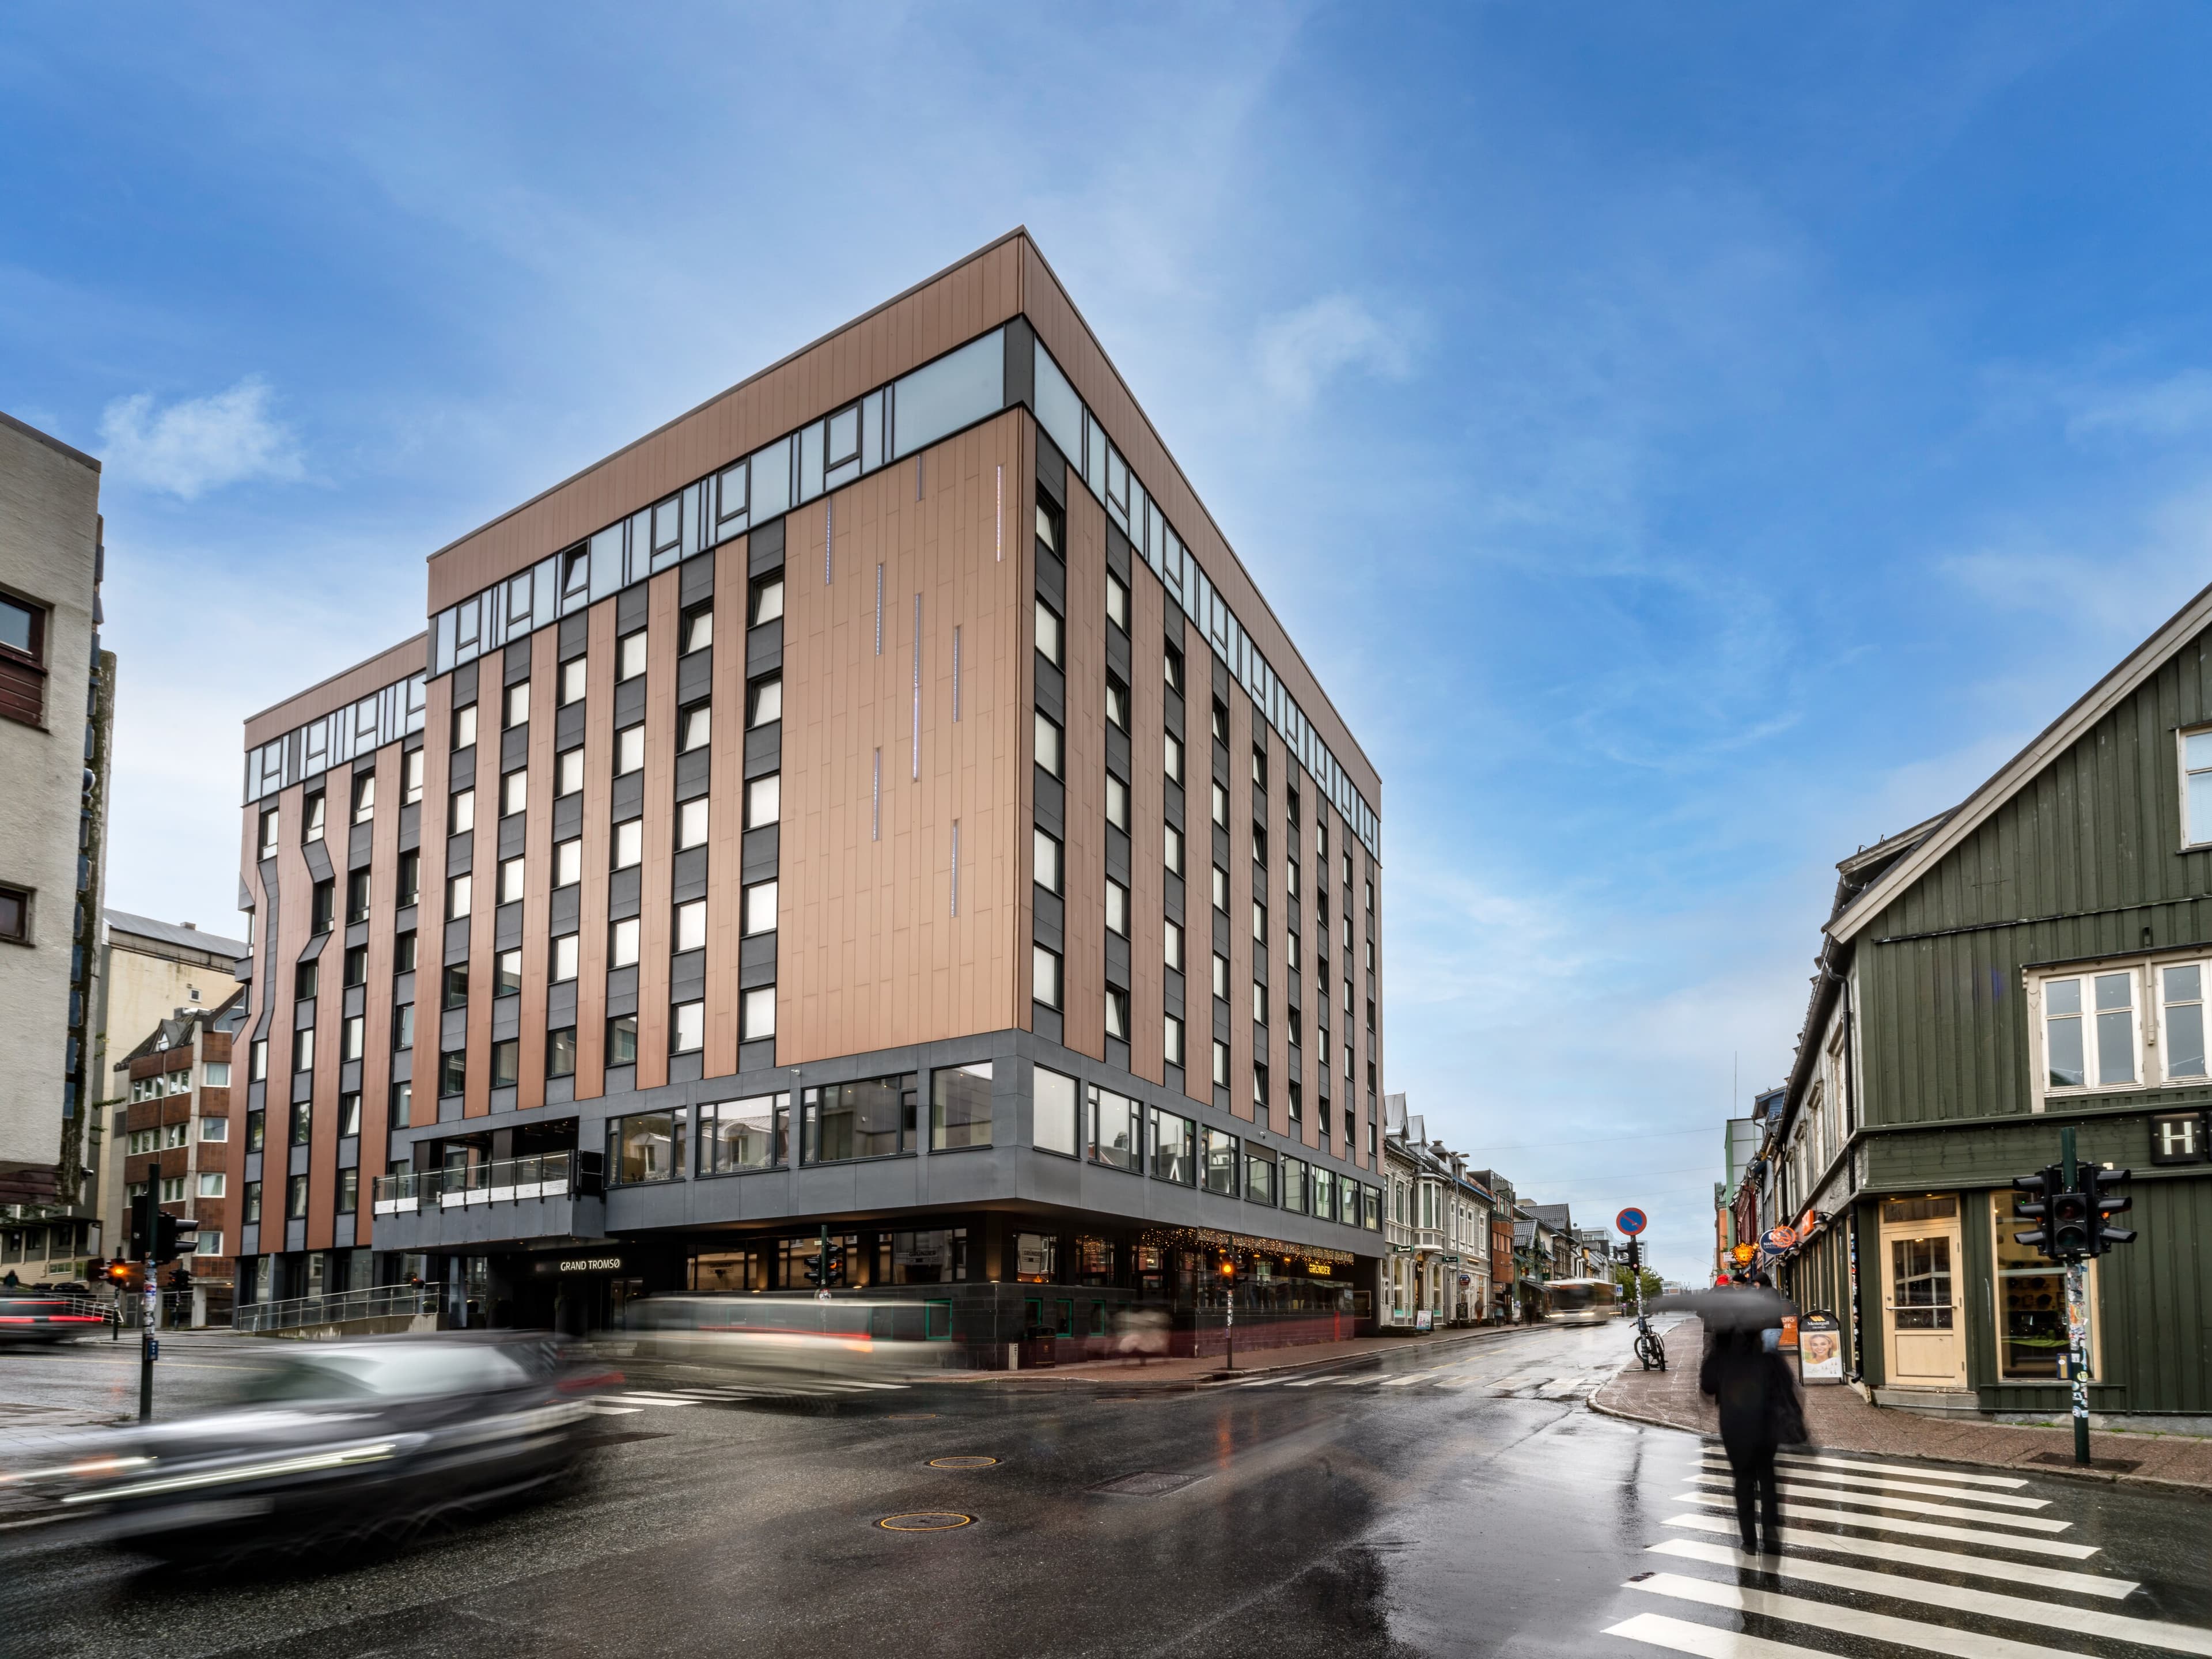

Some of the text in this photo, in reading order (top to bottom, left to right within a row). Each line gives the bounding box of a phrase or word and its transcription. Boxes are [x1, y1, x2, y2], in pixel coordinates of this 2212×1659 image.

[2162, 1122, 2193, 1155] H
[560, 1259, 620, 1271] GRAND TROMSØ
